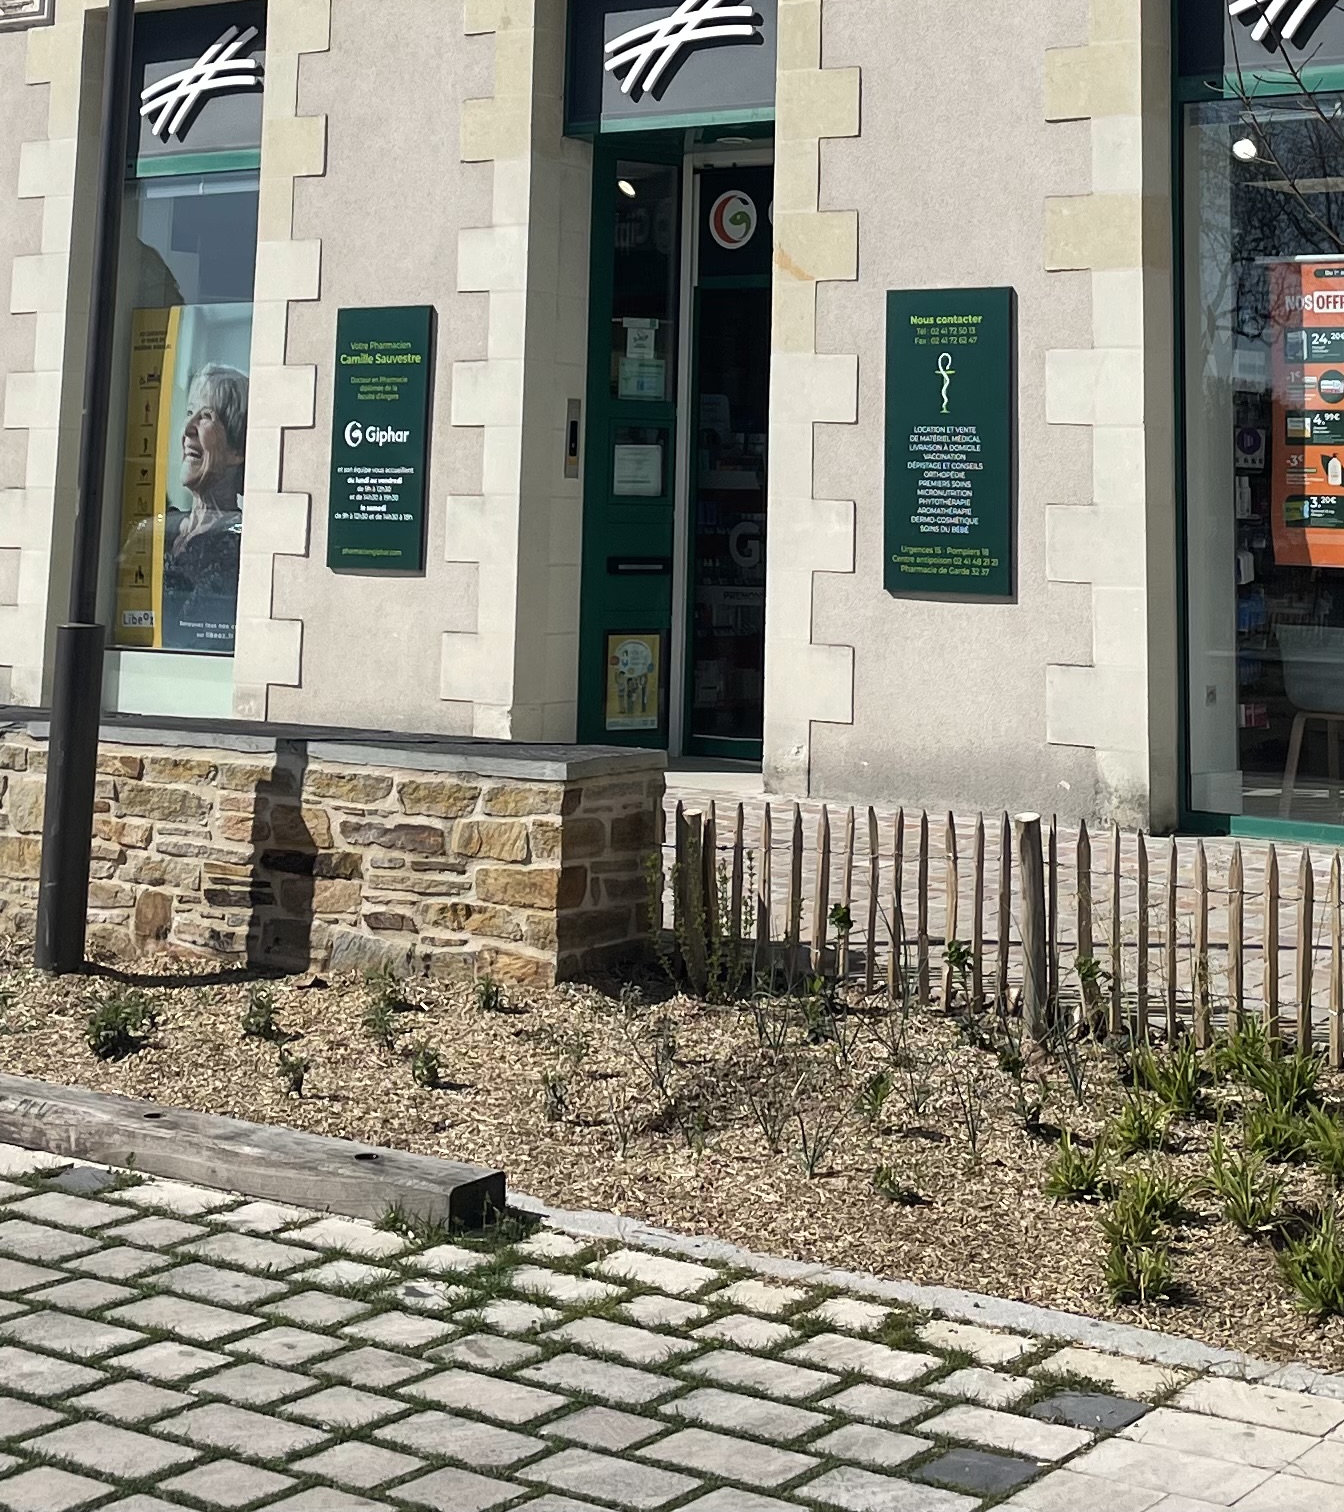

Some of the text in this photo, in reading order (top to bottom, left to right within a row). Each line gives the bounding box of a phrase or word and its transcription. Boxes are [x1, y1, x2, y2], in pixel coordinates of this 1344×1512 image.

[1285, 294, 1313, 311] NOS
[910, 314, 983, 325] Nous contacter
[930, 327, 940, 335] 02
[948, 327, 958, 335] 72
[351, 341, 369, 350] Votre
[948, 337, 958, 345] 72
[340, 353, 422, 364] Camille Sauvestre
[365, 425, 410, 447] Giphar
[951, 435, 981, 443] MÉDICAL
[943, 443, 948, 451] À
[923, 453, 967, 461] VACCINATION
[907, 461, 942, 469] DÉPISTAGE
[950, 462, 984, 470] CONSEILS
[923, 470, 966, 479] ORTHOPÉDIE
[918, 480, 972, 488] PREMIERS SOINS
[917, 489, 973, 497] MICRONUTRITION
[918, 497, 971, 506] PHYTOTHÉRAPIE
[917, 506, 972, 515] AROMATHÉRAPIE
[920, 524, 939, 533] SOINS
[940, 525, 951, 533] DU
[900, 545, 934, 554] Urgences
[946, 546, 981, 556] Pompiers
[892, 554, 915, 563] Centre
[916, 556, 953, 565] antipoison
[900, 564, 938, 574] Pharmacie
[938, 566, 948, 574] de
[948, 567, 970, 576] Garde
